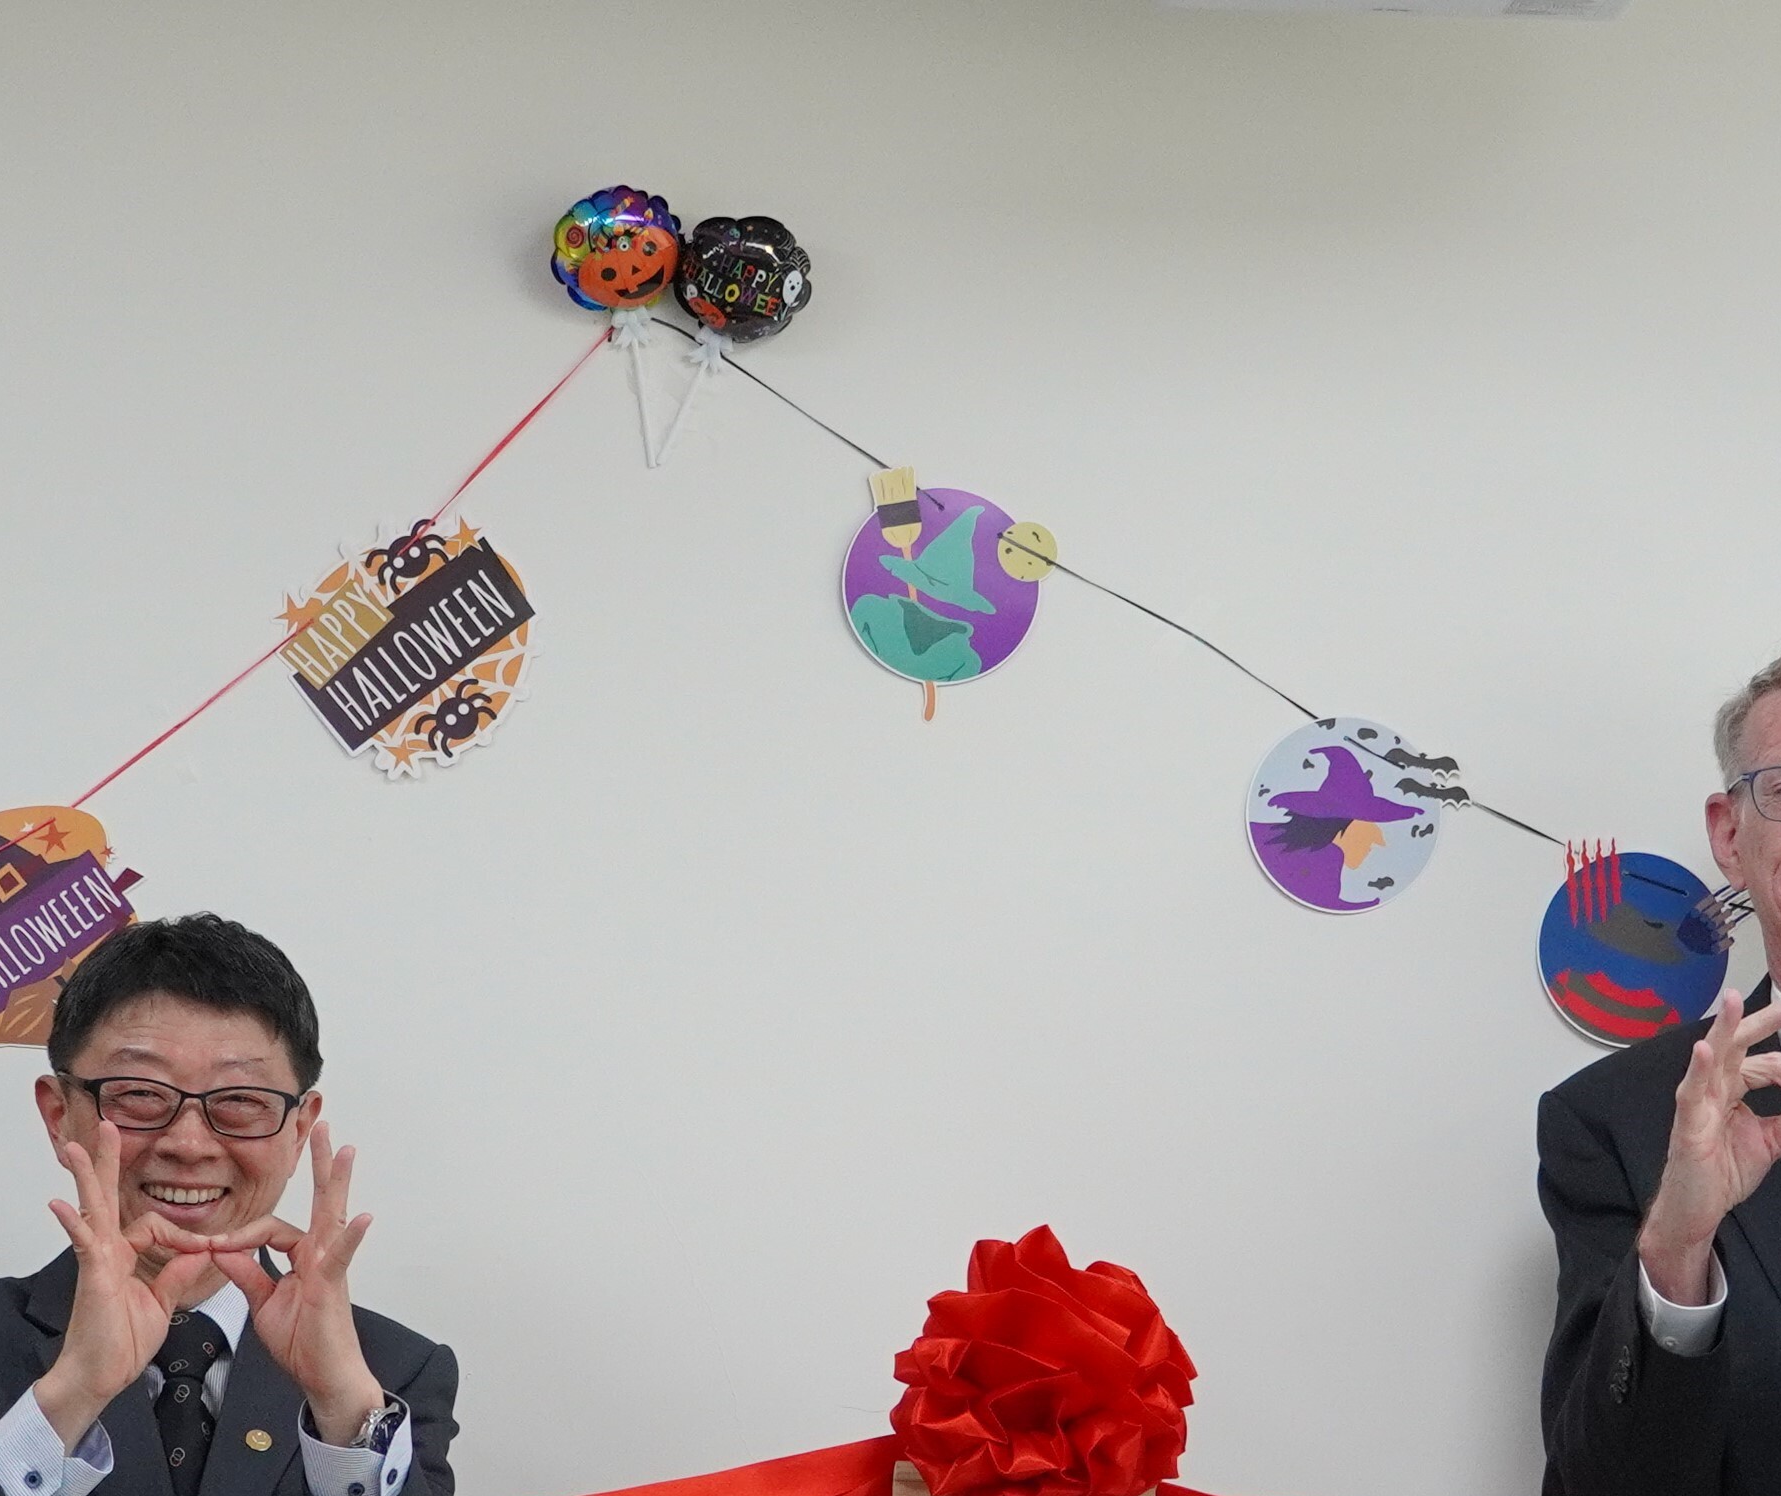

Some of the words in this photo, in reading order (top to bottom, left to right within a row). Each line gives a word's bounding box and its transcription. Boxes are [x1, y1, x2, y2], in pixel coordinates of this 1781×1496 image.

[719, 254, 782, 293] HAPPY
[286, 581, 388, 685] HAPPY
[325, 569, 516, 731] HALLOWEEN
